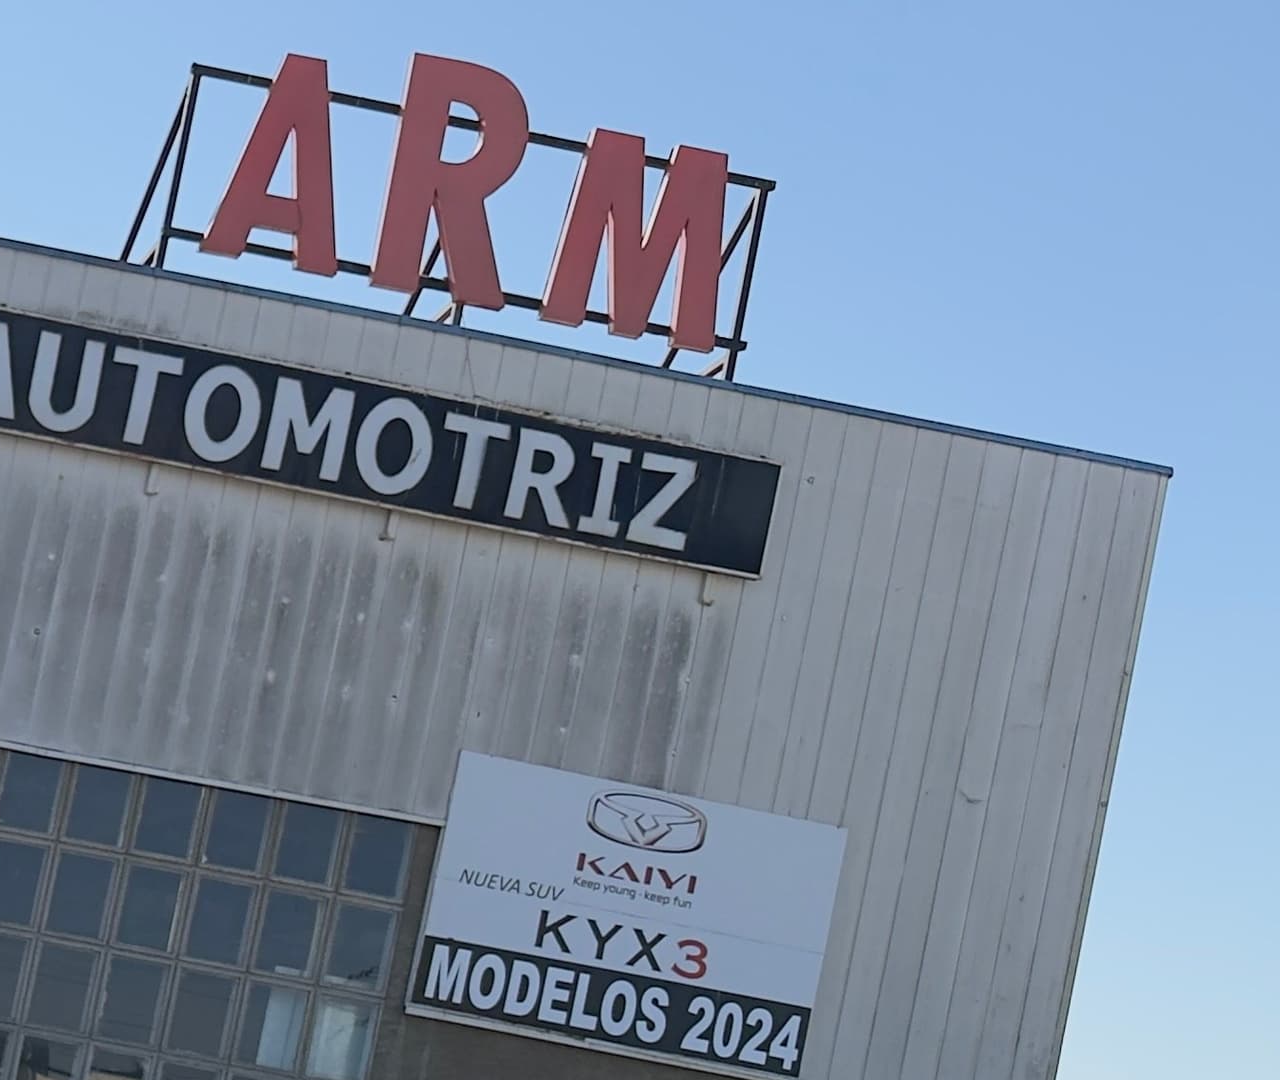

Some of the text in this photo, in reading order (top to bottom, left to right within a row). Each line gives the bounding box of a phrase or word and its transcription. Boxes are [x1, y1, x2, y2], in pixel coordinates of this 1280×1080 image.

[200, 52, 729, 353] ARM
[458, 868, 566, 901] NUEVA SUV
[572, 875, 692, 909] Keep young keep fun
[534, 909, 708, 979] KYX3
[423, 943, 803, 1072] MODELOS 2024
